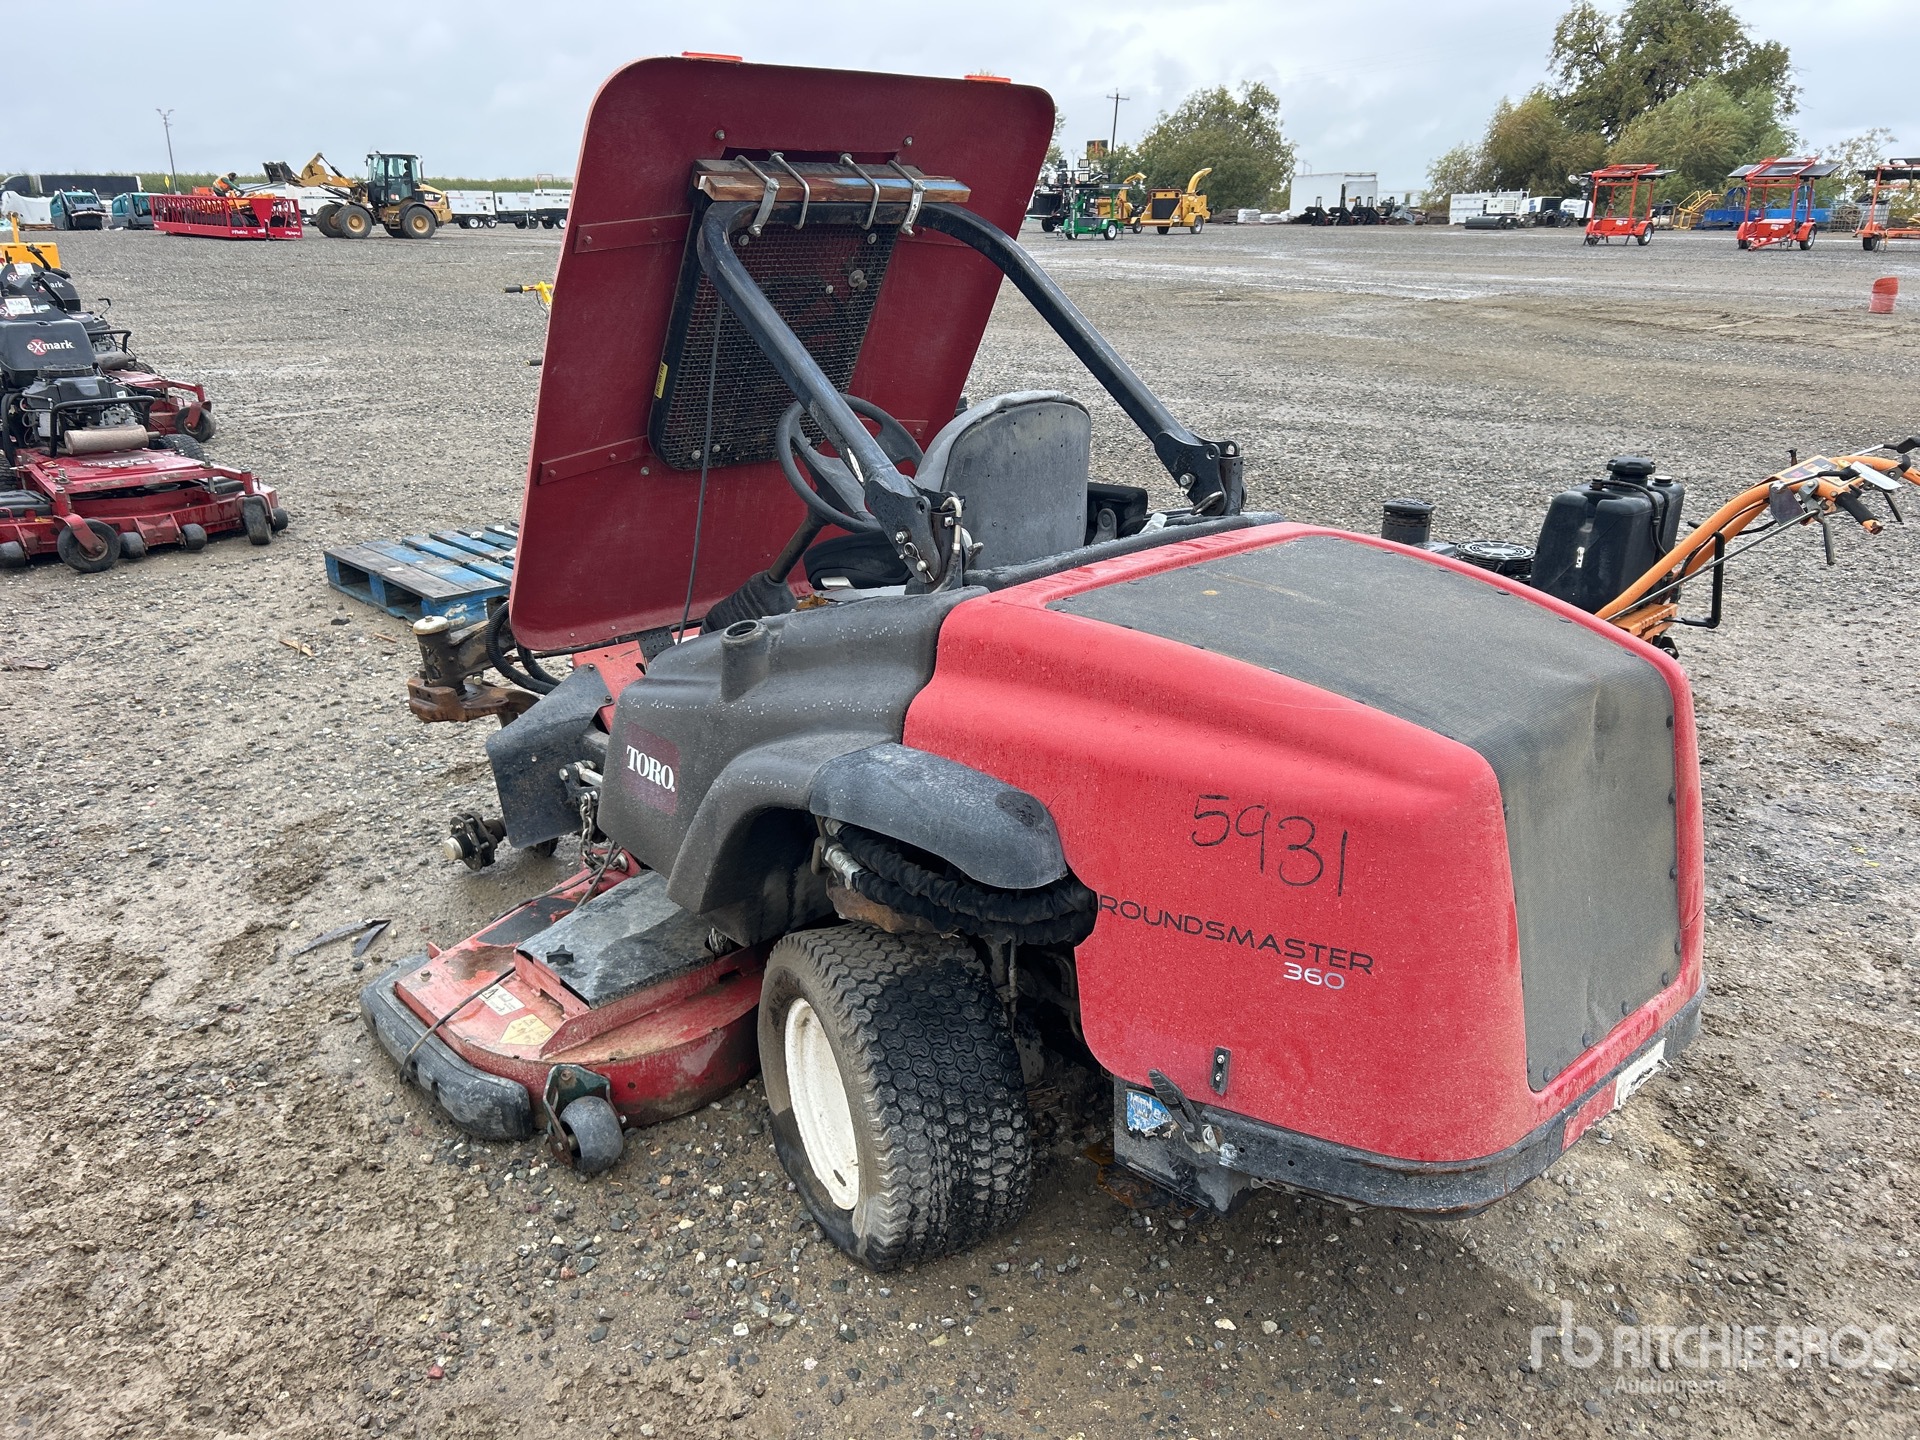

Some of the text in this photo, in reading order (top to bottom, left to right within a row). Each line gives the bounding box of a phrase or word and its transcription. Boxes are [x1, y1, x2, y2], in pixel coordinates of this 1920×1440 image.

[424, 193, 434, 201] CAT
[626, 745, 675, 791] TORO
[1191, 794, 1348, 897] 5931
[1098, 894, 1375, 976] ROUNDSMASTER
[1283, 961, 1346, 991] 360
